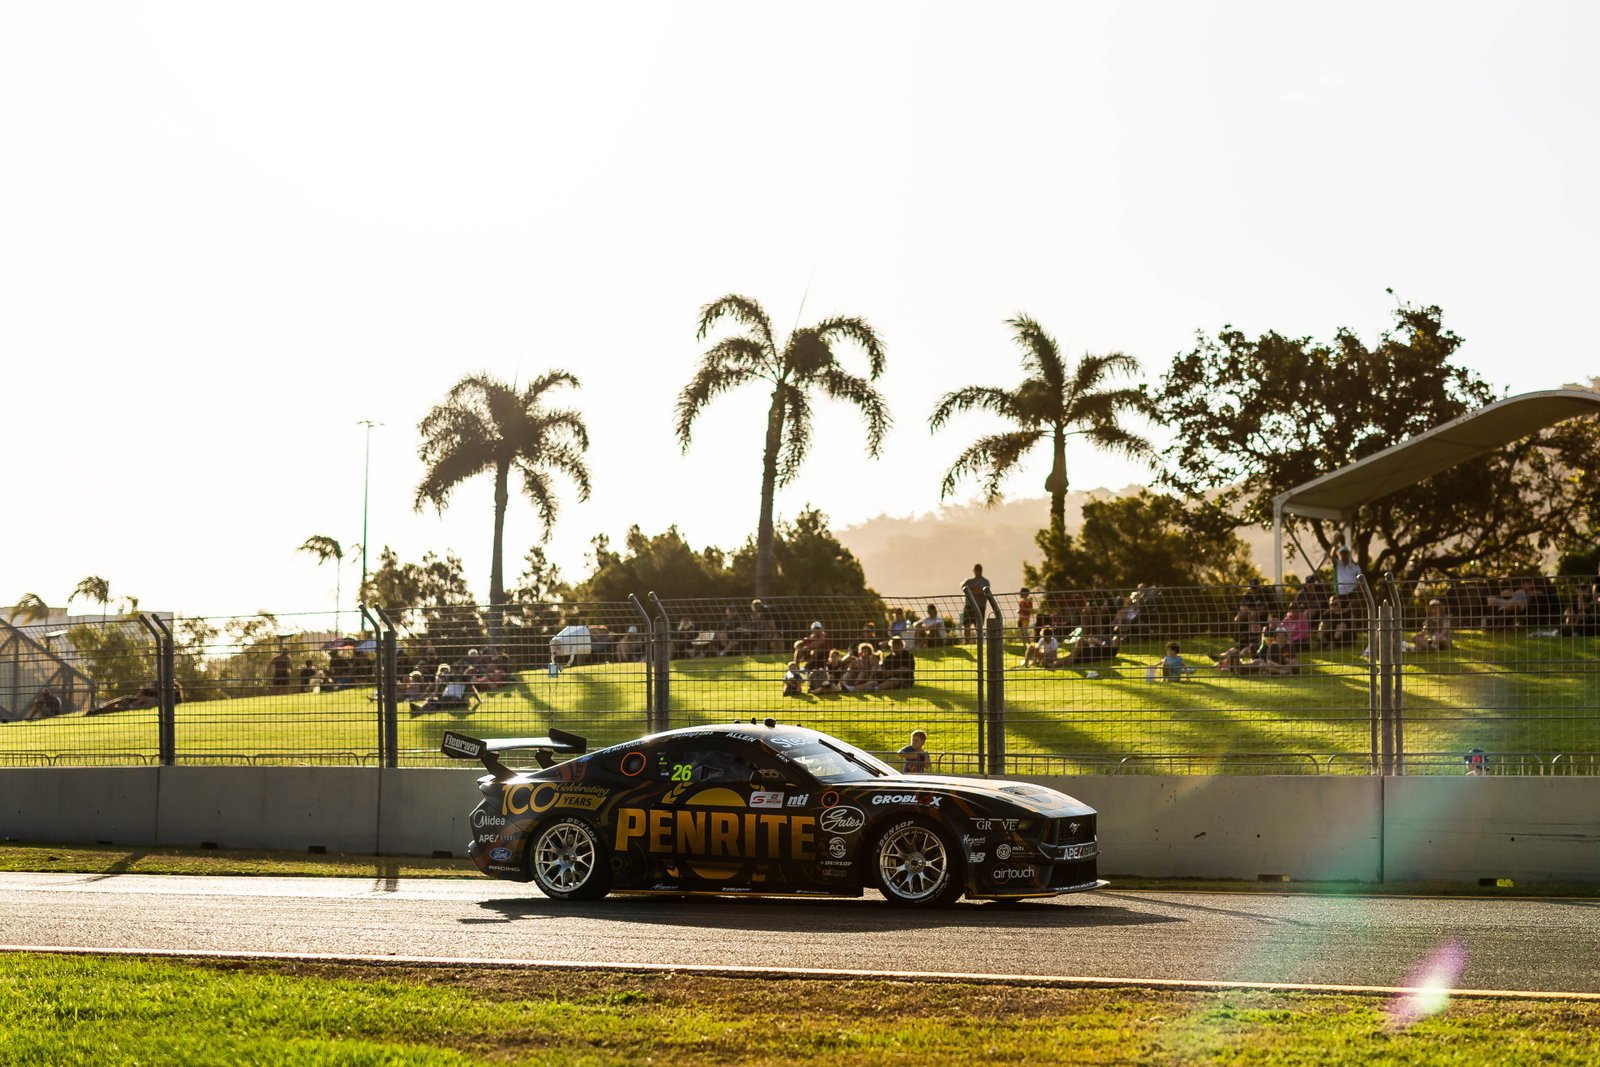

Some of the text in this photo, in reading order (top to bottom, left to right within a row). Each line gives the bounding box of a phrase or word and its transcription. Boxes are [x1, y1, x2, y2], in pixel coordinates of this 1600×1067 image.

[444, 733, 481, 754] Floorway
[726, 732, 757, 743] ALLEN
[671, 764, 693, 781] 26
[556, 782, 611, 797] Celebrating
[563, 796, 592, 807] YEARS
[787, 794, 809, 805] nti
[473, 809, 506, 828] Midea
[821, 808, 865, 832] Gates
[566, 817, 598, 843] DUNLOP
[615, 808, 816, 860] PENRITE
[879, 820, 914, 848] DUNLOP
[829, 844, 847, 852] ACL
[993, 866, 1035, 879] airtouch
